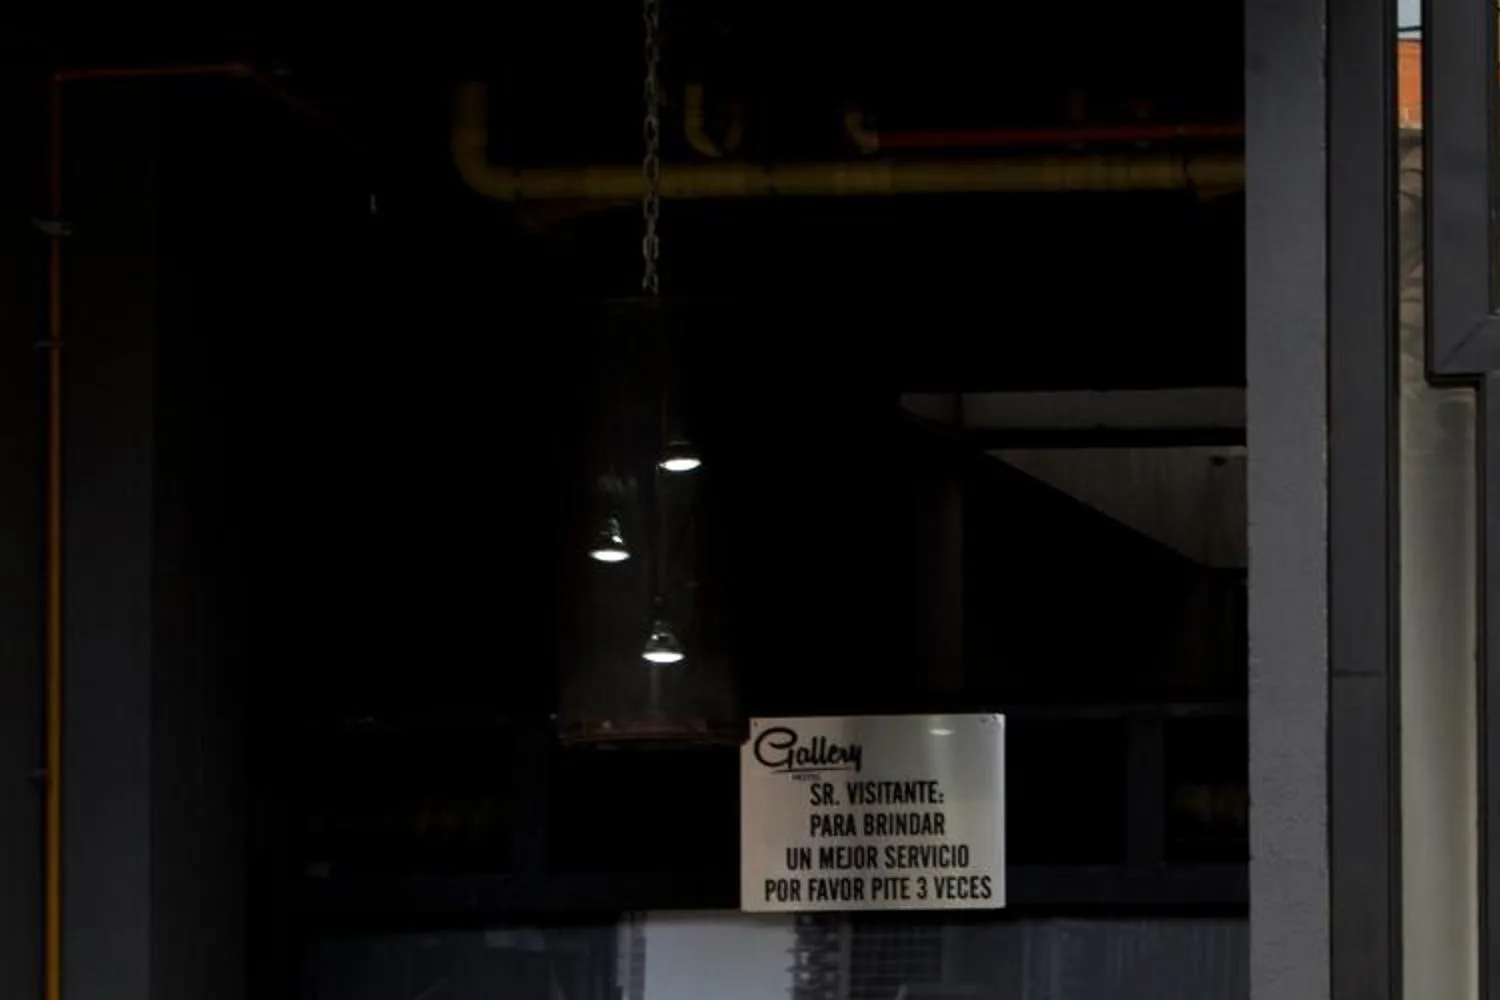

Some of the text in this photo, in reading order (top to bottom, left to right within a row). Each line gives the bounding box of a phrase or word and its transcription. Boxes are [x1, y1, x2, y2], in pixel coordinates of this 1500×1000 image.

[754, 727, 862, 772] Gallery
[810, 781, 944, 806] SR. VISITANTE:
[810, 812, 945, 837] PARA BRINDAR
[786, 844, 969, 870] UN MEJOR SERVICIO
[765, 875, 992, 901] POR FAVOR PITE 3 VECES
